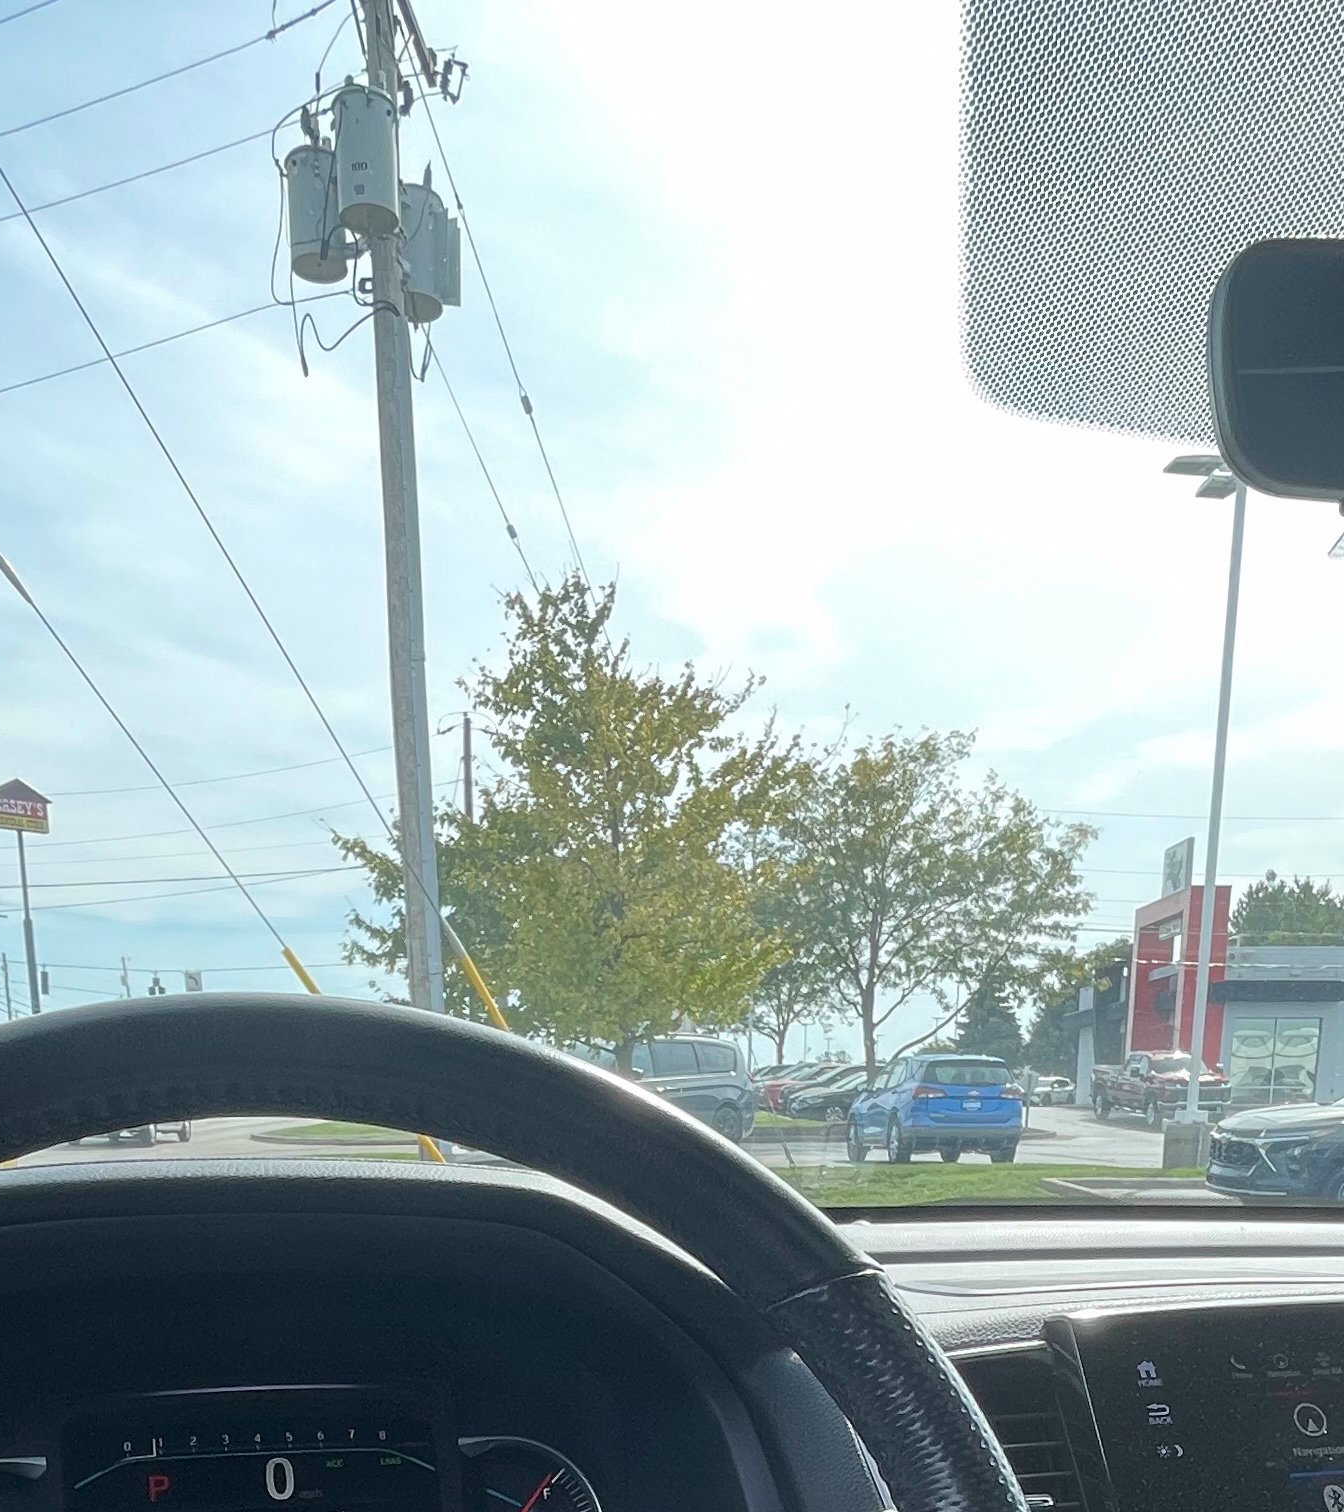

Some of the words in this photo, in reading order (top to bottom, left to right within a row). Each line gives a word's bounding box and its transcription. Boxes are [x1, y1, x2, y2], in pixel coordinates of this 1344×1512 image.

[1148, 1416, 1173, 1425] BACK
[222, 1434, 229, 1445] 3
[254, 1432, 261, 1443] 4
[285, 1431, 293, 1442] 5
[317, 1430, 325, 1440] 6
[348, 1429, 355, 1439] 7
[123, 1441, 132, 1453] 0
[158, 1438, 163, 1448] 1
[189, 1436, 197, 1447] 2
[265, 1457, 295, 1501] 0
[148, 1475, 170, 1503] P
[543, 1487, 551, 1500] F
